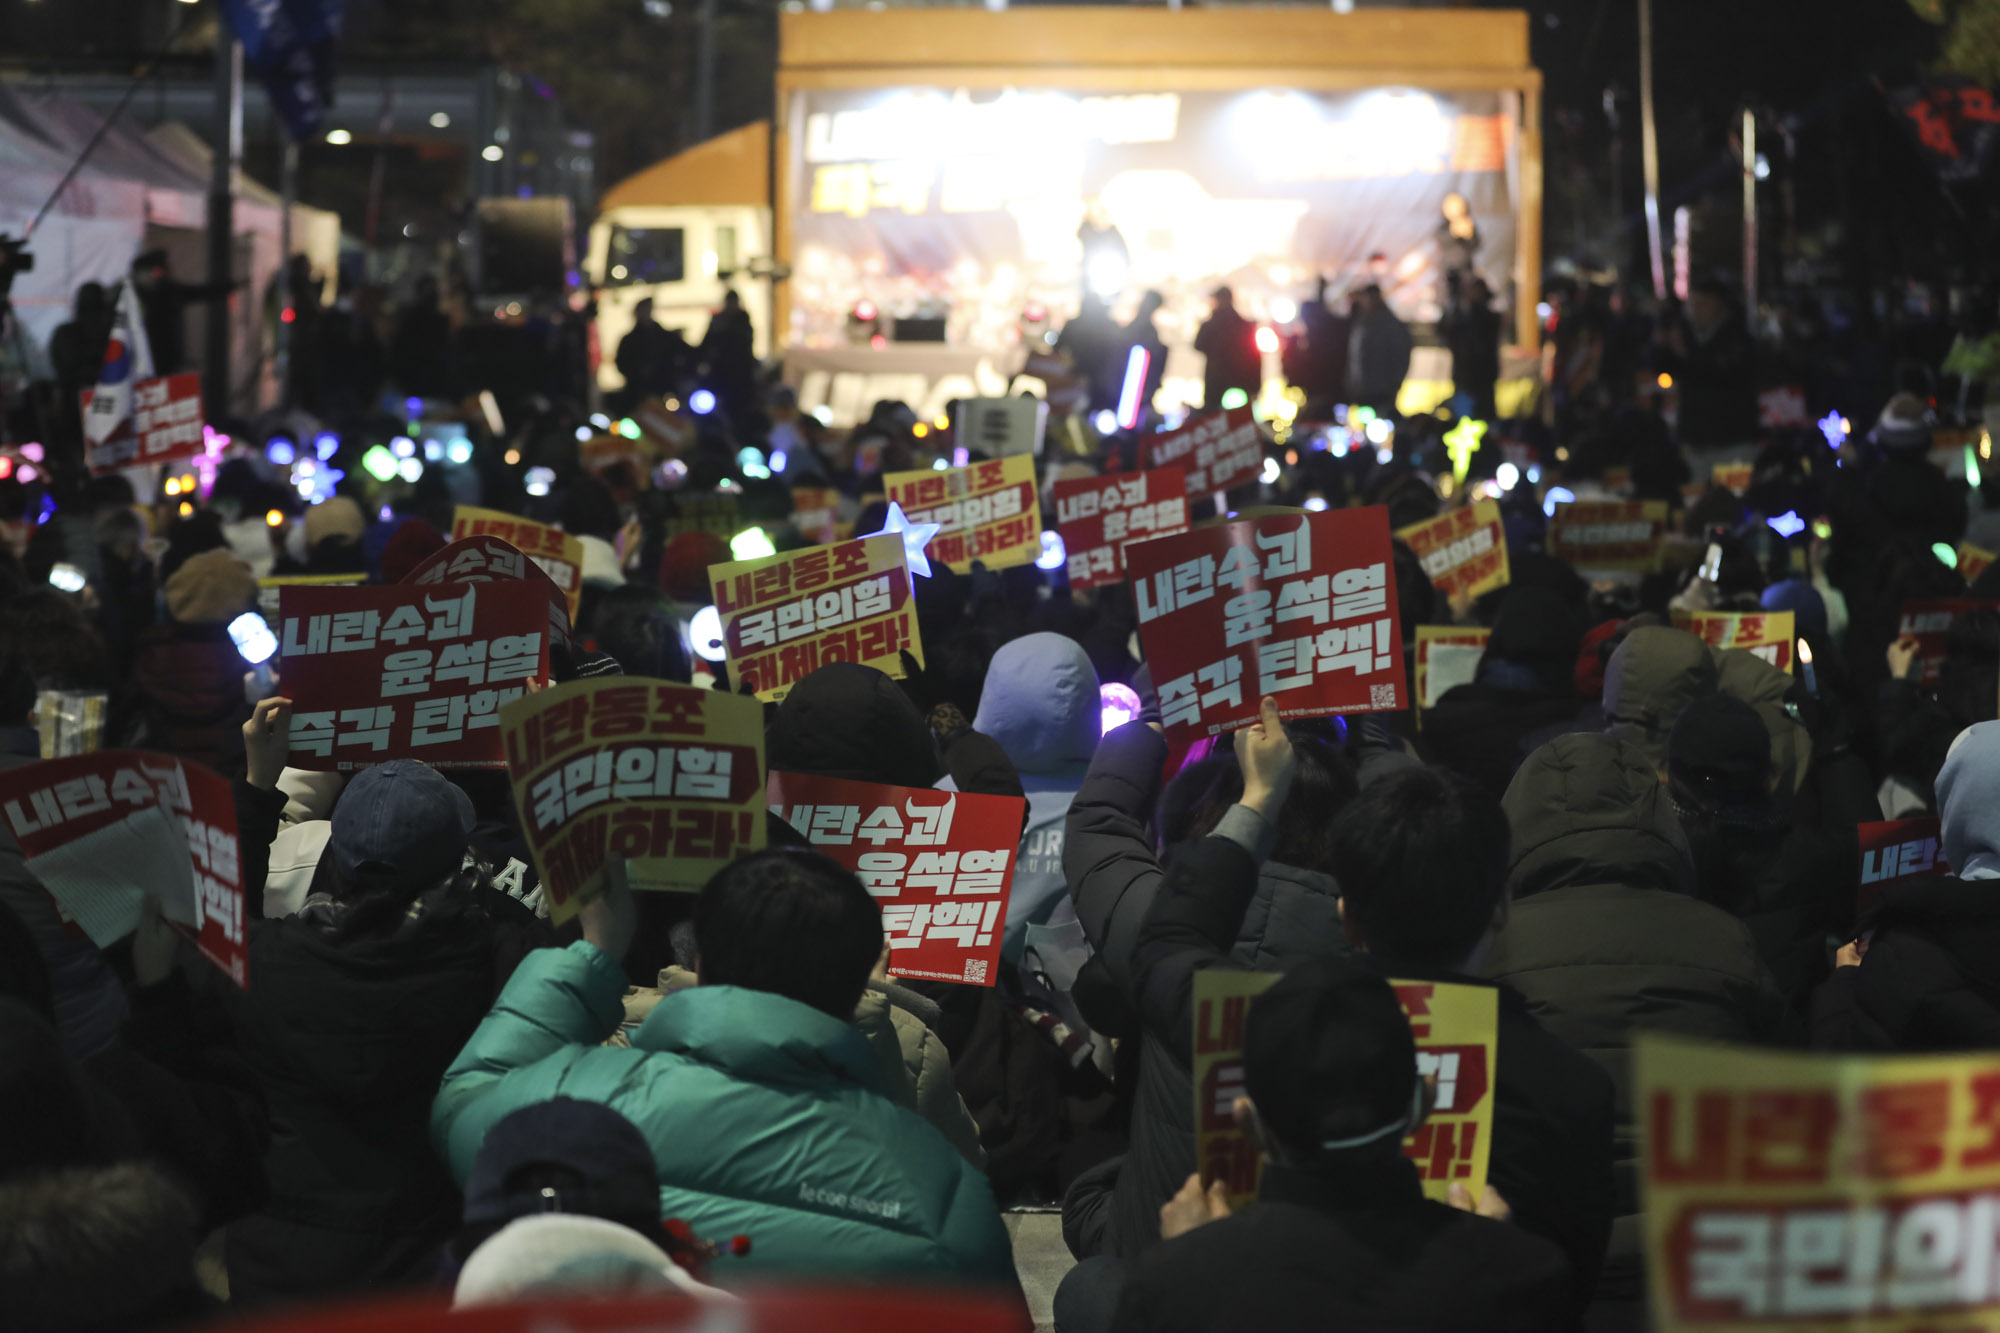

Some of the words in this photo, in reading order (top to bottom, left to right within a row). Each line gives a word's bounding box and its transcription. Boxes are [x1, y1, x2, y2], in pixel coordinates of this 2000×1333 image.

[1057, 470, 1147, 524] 내란수괴
[1102, 496, 1186, 542] 윤석열
[716, 539, 870, 615] 내란동조
[1067, 545, 1115, 580] 즉각
[1135, 514, 1311, 624] 내란수괴
[281, 582, 476, 657] 내란수괴
[739, 575, 892, 647] 국민의힘
[1224, 562, 1387, 648] 윤석열
[380, 632, 542, 698] 윤석열
[738, 613, 911, 694] 해체하라!
[1157, 654, 1243, 728] 즉각
[1258, 618, 1392, 697] 탄핵!
[288, 705, 396, 757] 즉각
[506, 685, 706, 782] 내란동조
[4, 757, 193, 838] 내란수괴
[532, 746, 733, 831] 국민의힘
[541, 806, 754, 906] 해체하라!
[856, 849, 1011, 898] 윤석열
[882, 901, 1002, 950] 탄핵!
